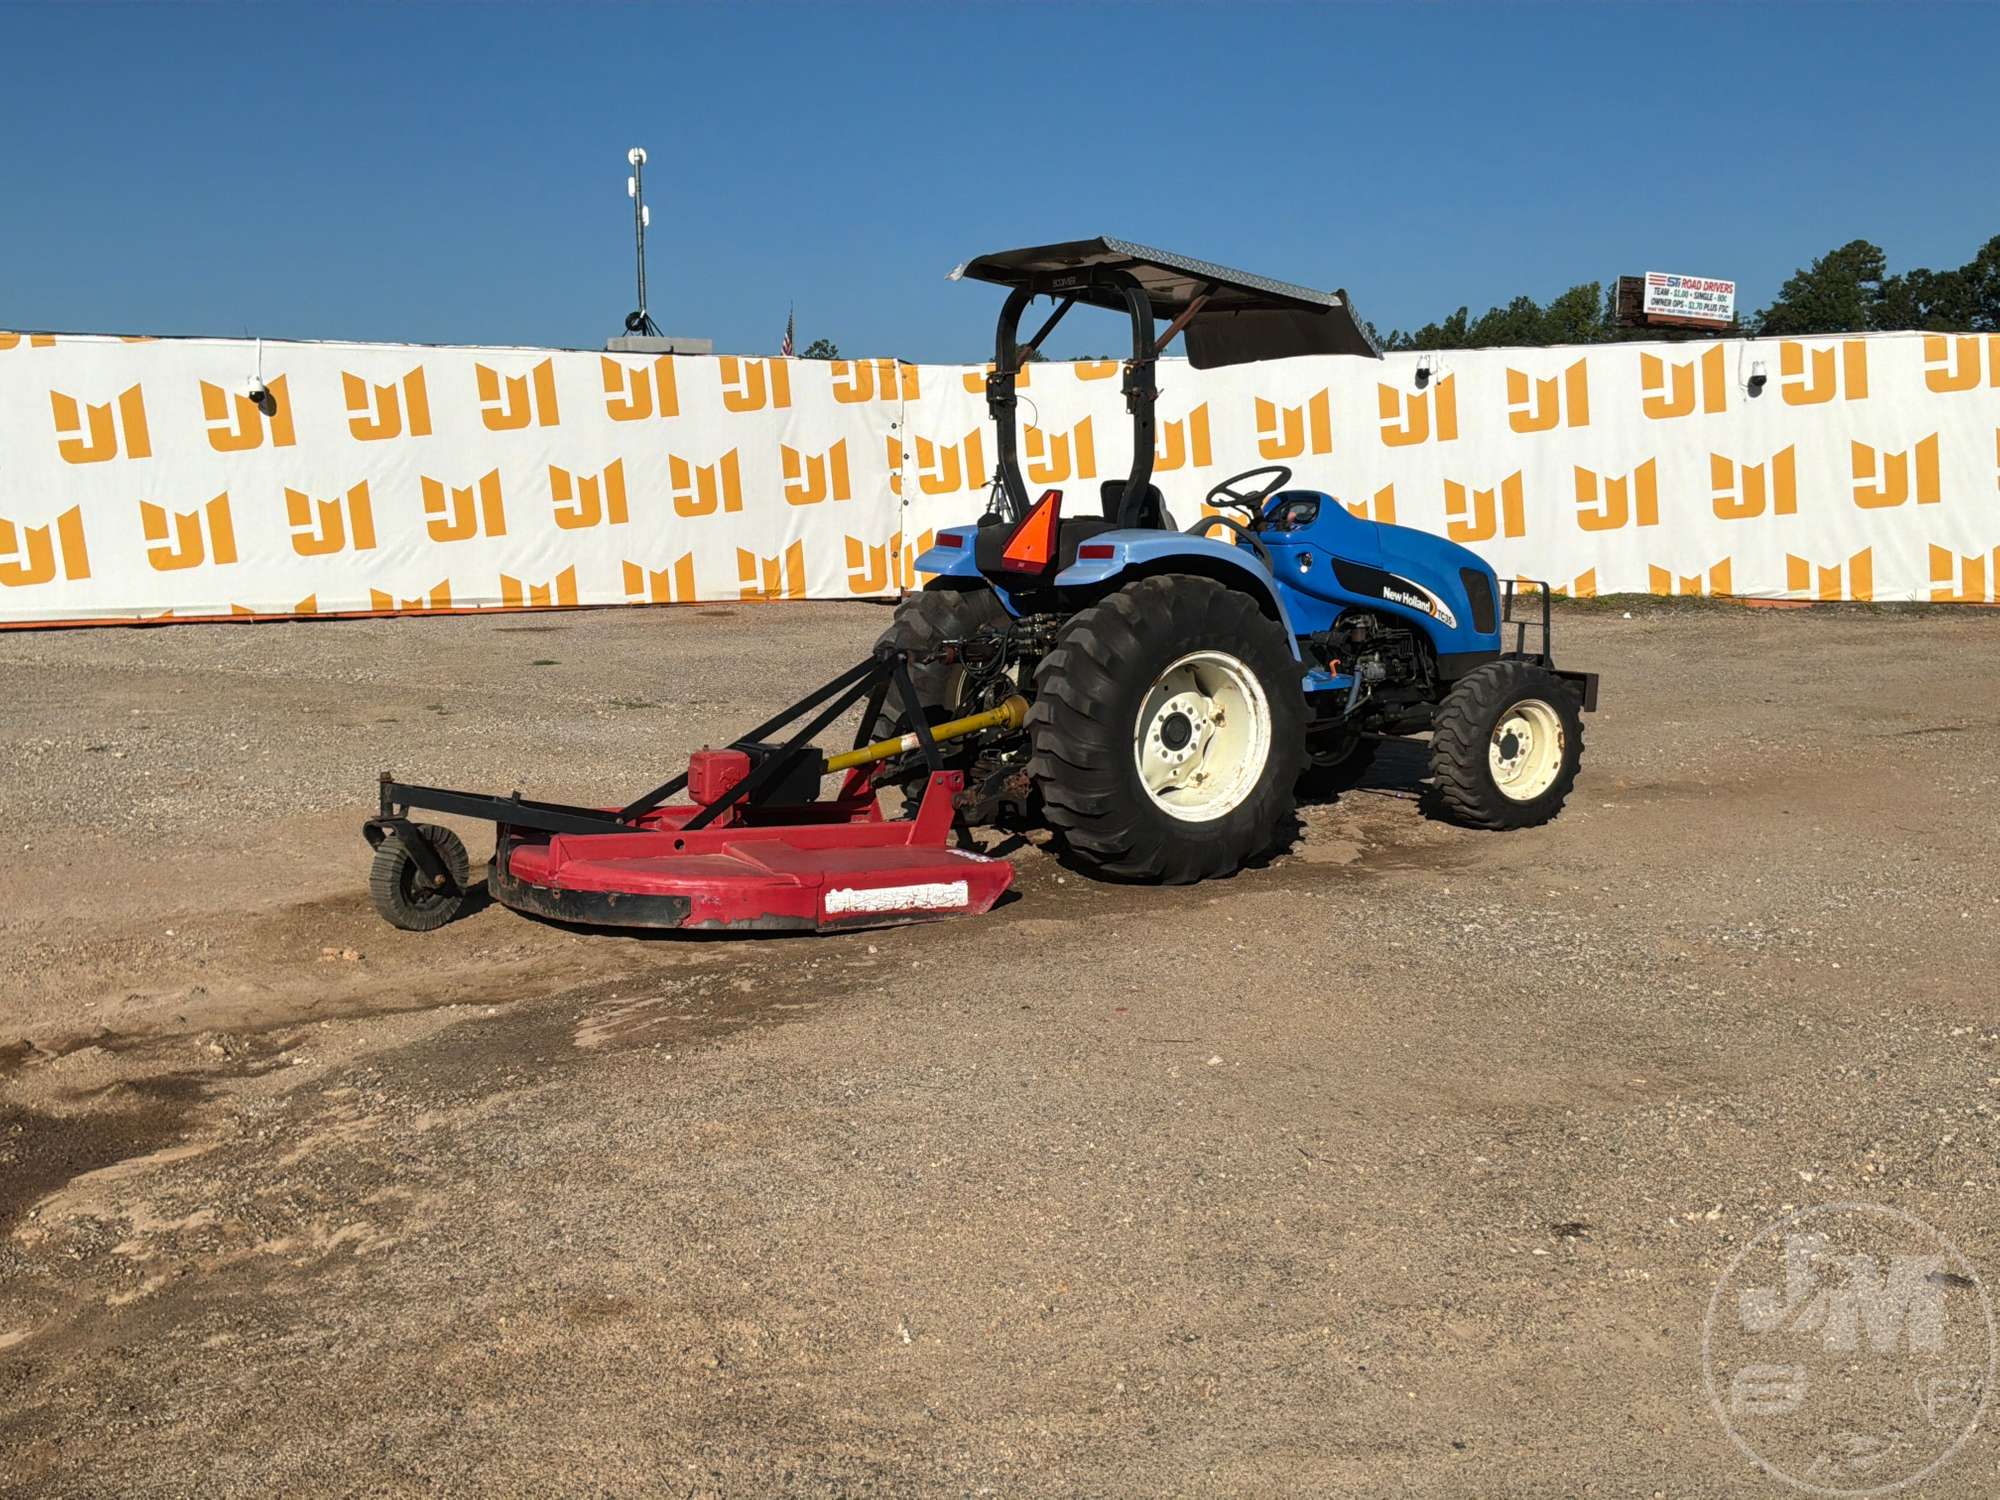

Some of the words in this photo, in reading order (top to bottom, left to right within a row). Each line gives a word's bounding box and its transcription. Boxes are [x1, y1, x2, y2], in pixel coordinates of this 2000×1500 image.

[1682, 278, 1701, 290] ROAD
[1703, 281, 1733, 294] DRIVERS
[1654, 287, 1669, 296] TEAM
[1694, 291, 1713, 301] SINGLE
[1651, 298, 1671, 307] OWNER
[1672, 299, 1684, 308] OPS
[1703, 303, 1717, 312] PLUS
[1383, 586, 1402, 602] New
[1403, 592, 1430, 612] Holland
